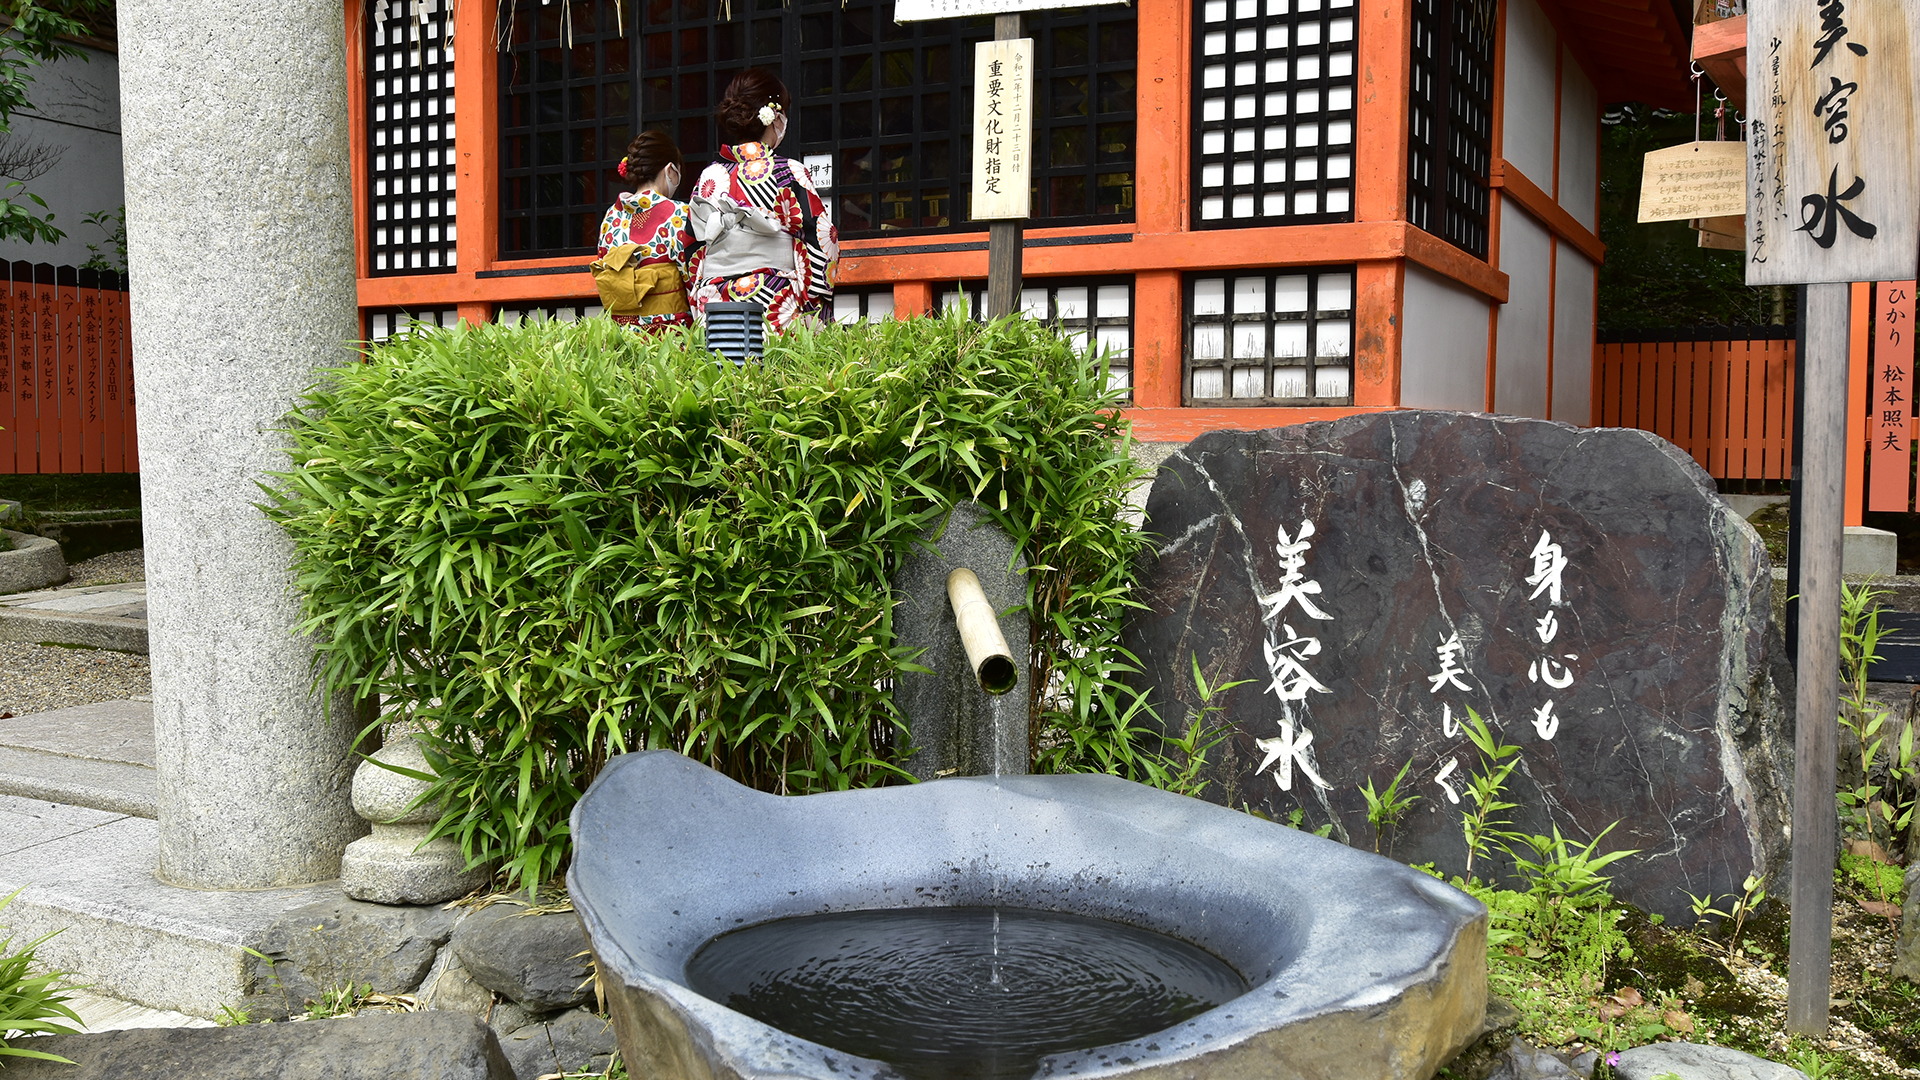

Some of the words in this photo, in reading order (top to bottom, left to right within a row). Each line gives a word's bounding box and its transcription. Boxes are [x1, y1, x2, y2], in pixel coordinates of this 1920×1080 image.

[809, 163, 832, 177] 押す
[985, 59, 1004, 194] 重要文化財指定
[1012, 52, 1023, 173] 令和二年十二月二十三日付
[18, 290, 32, 401] 株式会社京都大和
[41, 292, 54, 400] 株式会社アルビオン
[1886, 286, 1906, 347] ひかり
[1881, 364, 1906, 451] 松本照夫
[1255, 518, 1334, 791] 美容水
[1524, 529, 1578, 740] 身も心も
[1427, 632, 1472, 804] 美しく
